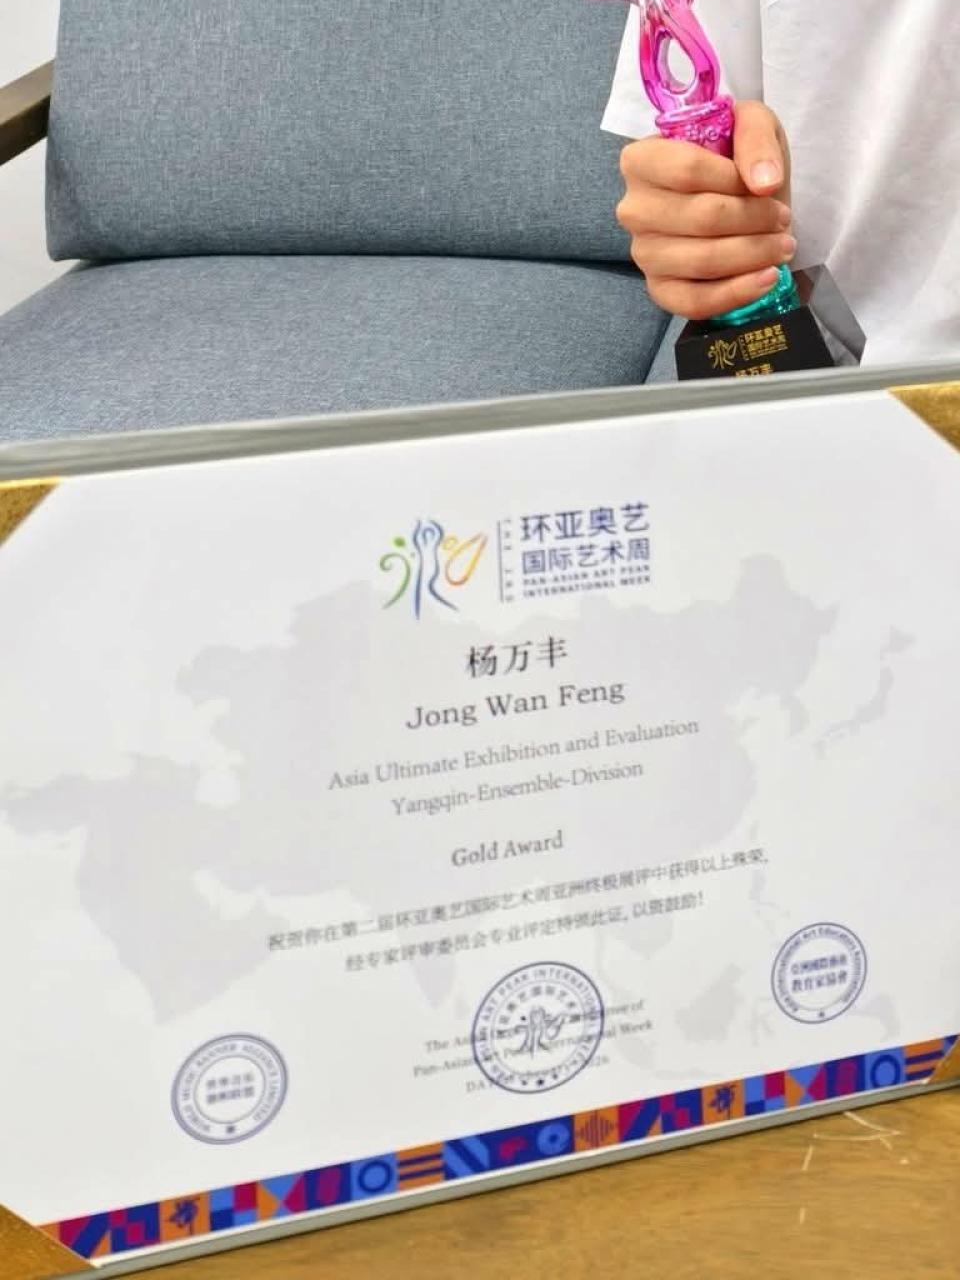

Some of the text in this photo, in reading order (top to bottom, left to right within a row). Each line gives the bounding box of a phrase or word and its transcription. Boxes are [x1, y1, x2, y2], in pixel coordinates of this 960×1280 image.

[520, 502, 650, 542] 环亚奥艺
[522, 537, 650, 575] 国际艺术周
[465, 636, 568, 679] 杨万丰
[405, 681, 626, 730] Jong Wan Feng
[328, 718, 700, 791] Asia Ultimate Exhibition and Evaluation
[391, 761, 644, 817] Yangqin-Ensemble-Division
[451, 829, 565, 867] Gold Award
